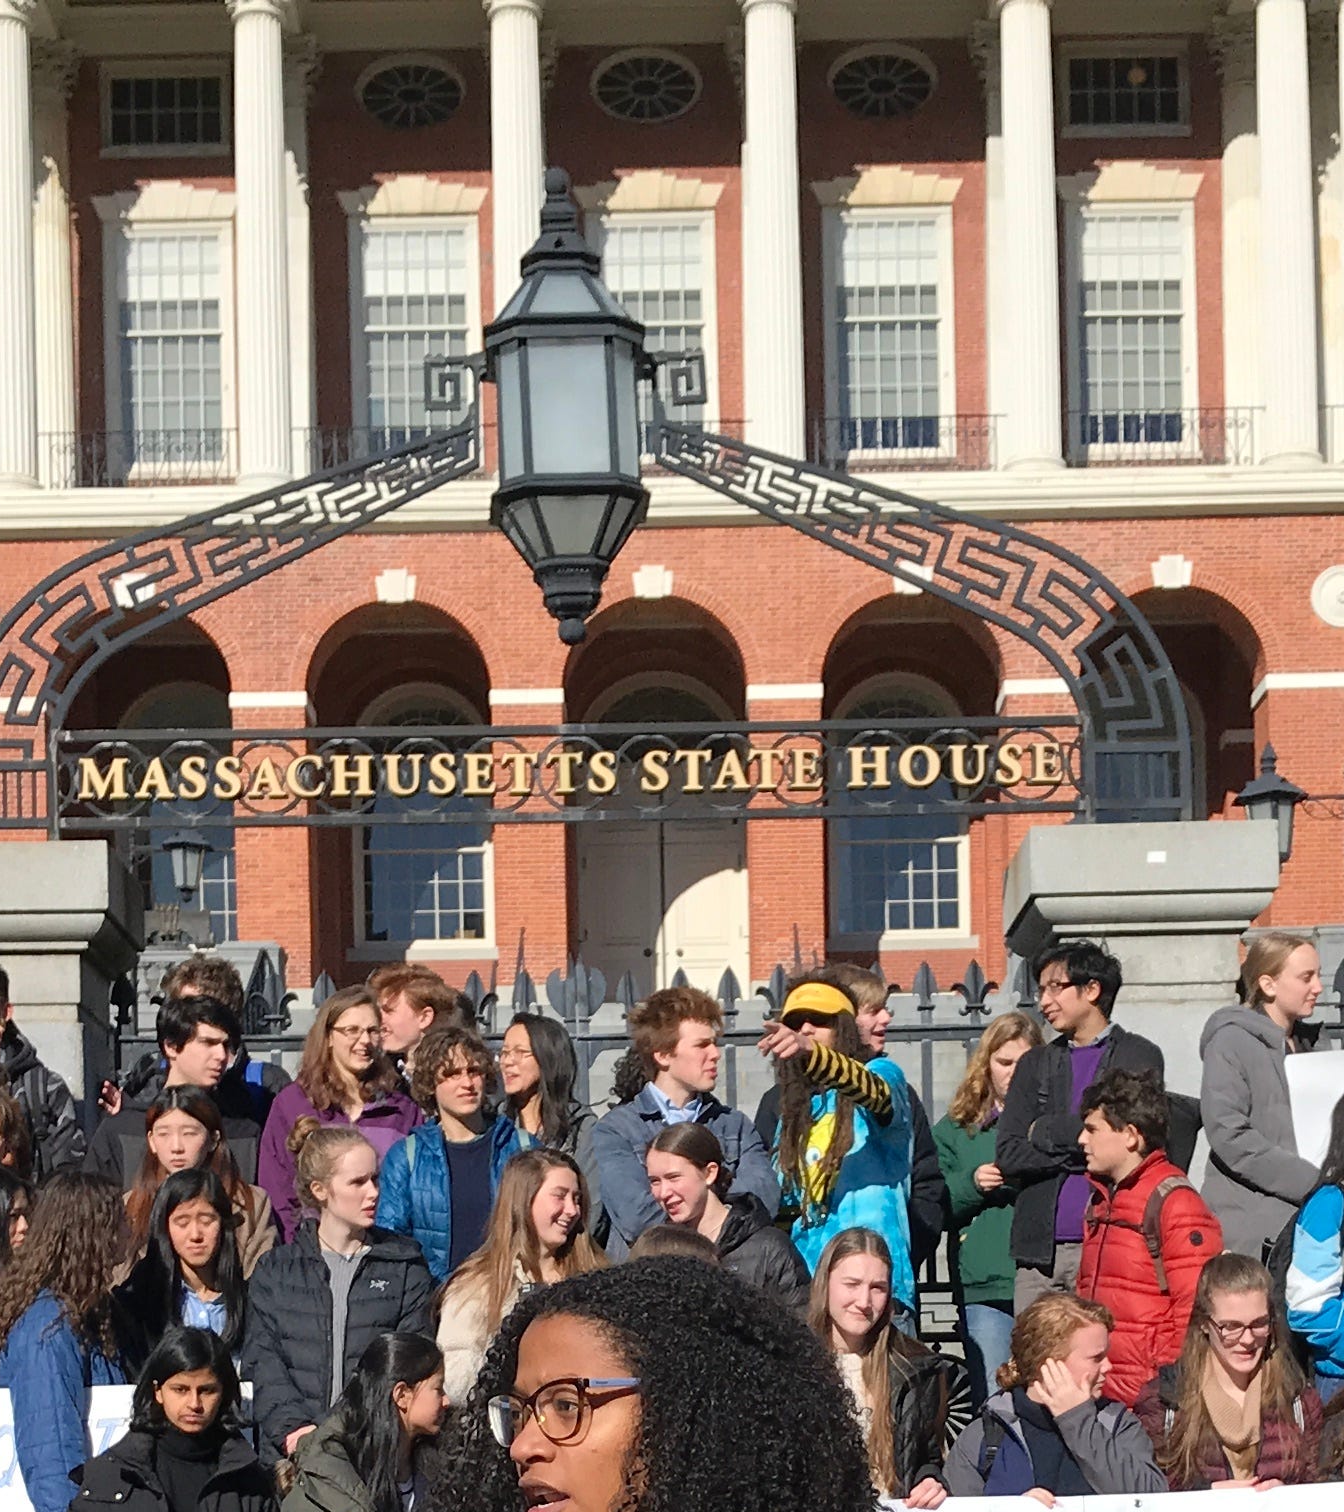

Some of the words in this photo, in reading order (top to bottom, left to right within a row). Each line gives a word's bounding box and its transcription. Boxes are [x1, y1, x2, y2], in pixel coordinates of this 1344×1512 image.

[78, 750, 618, 801] MASSACHUSETTS
[639, 746, 825, 793] STATE
[847, 741, 1066, 790] HOUSE
